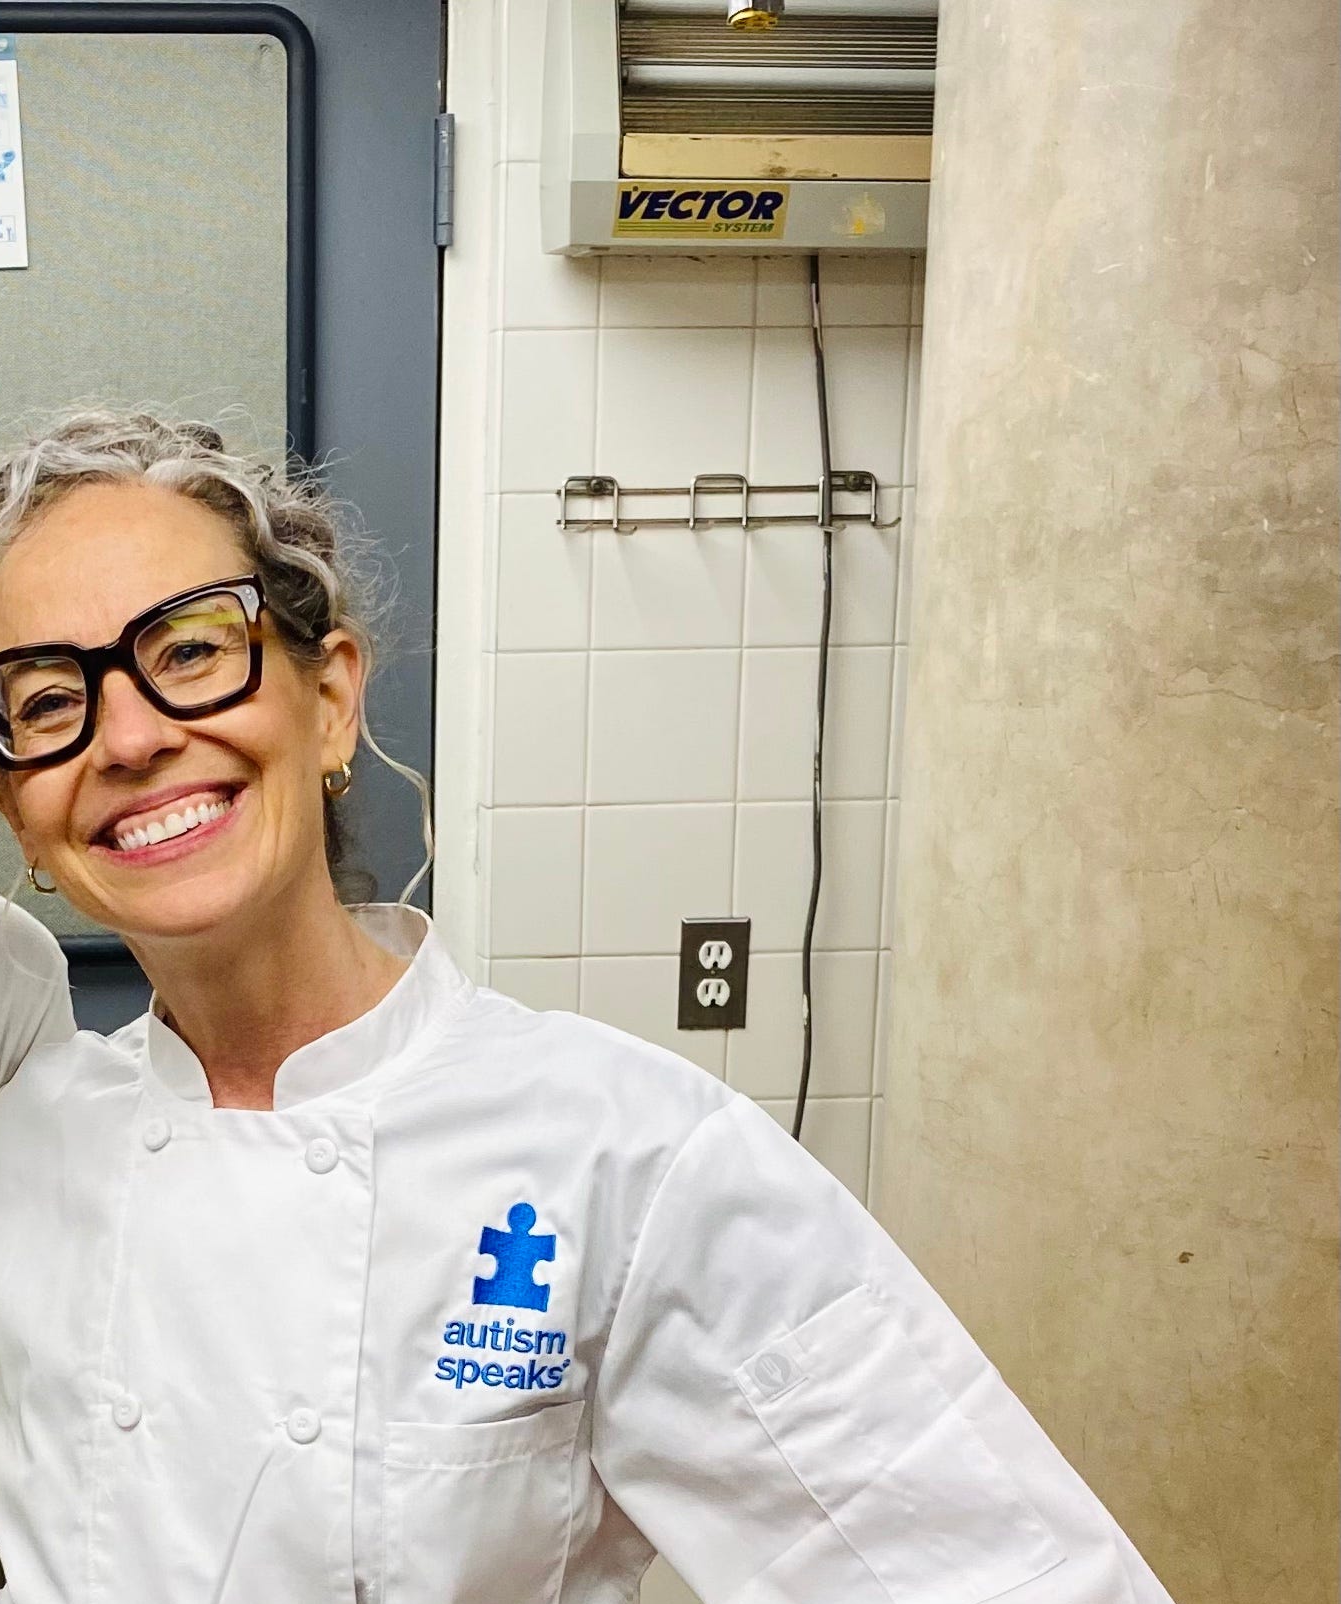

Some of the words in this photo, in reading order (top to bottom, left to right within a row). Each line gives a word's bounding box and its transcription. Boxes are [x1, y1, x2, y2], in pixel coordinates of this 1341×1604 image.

[618, 190, 784, 220] VECTOR
[712, 222, 775, 233] SYSTEM
[442, 1317, 567, 1355] autism
